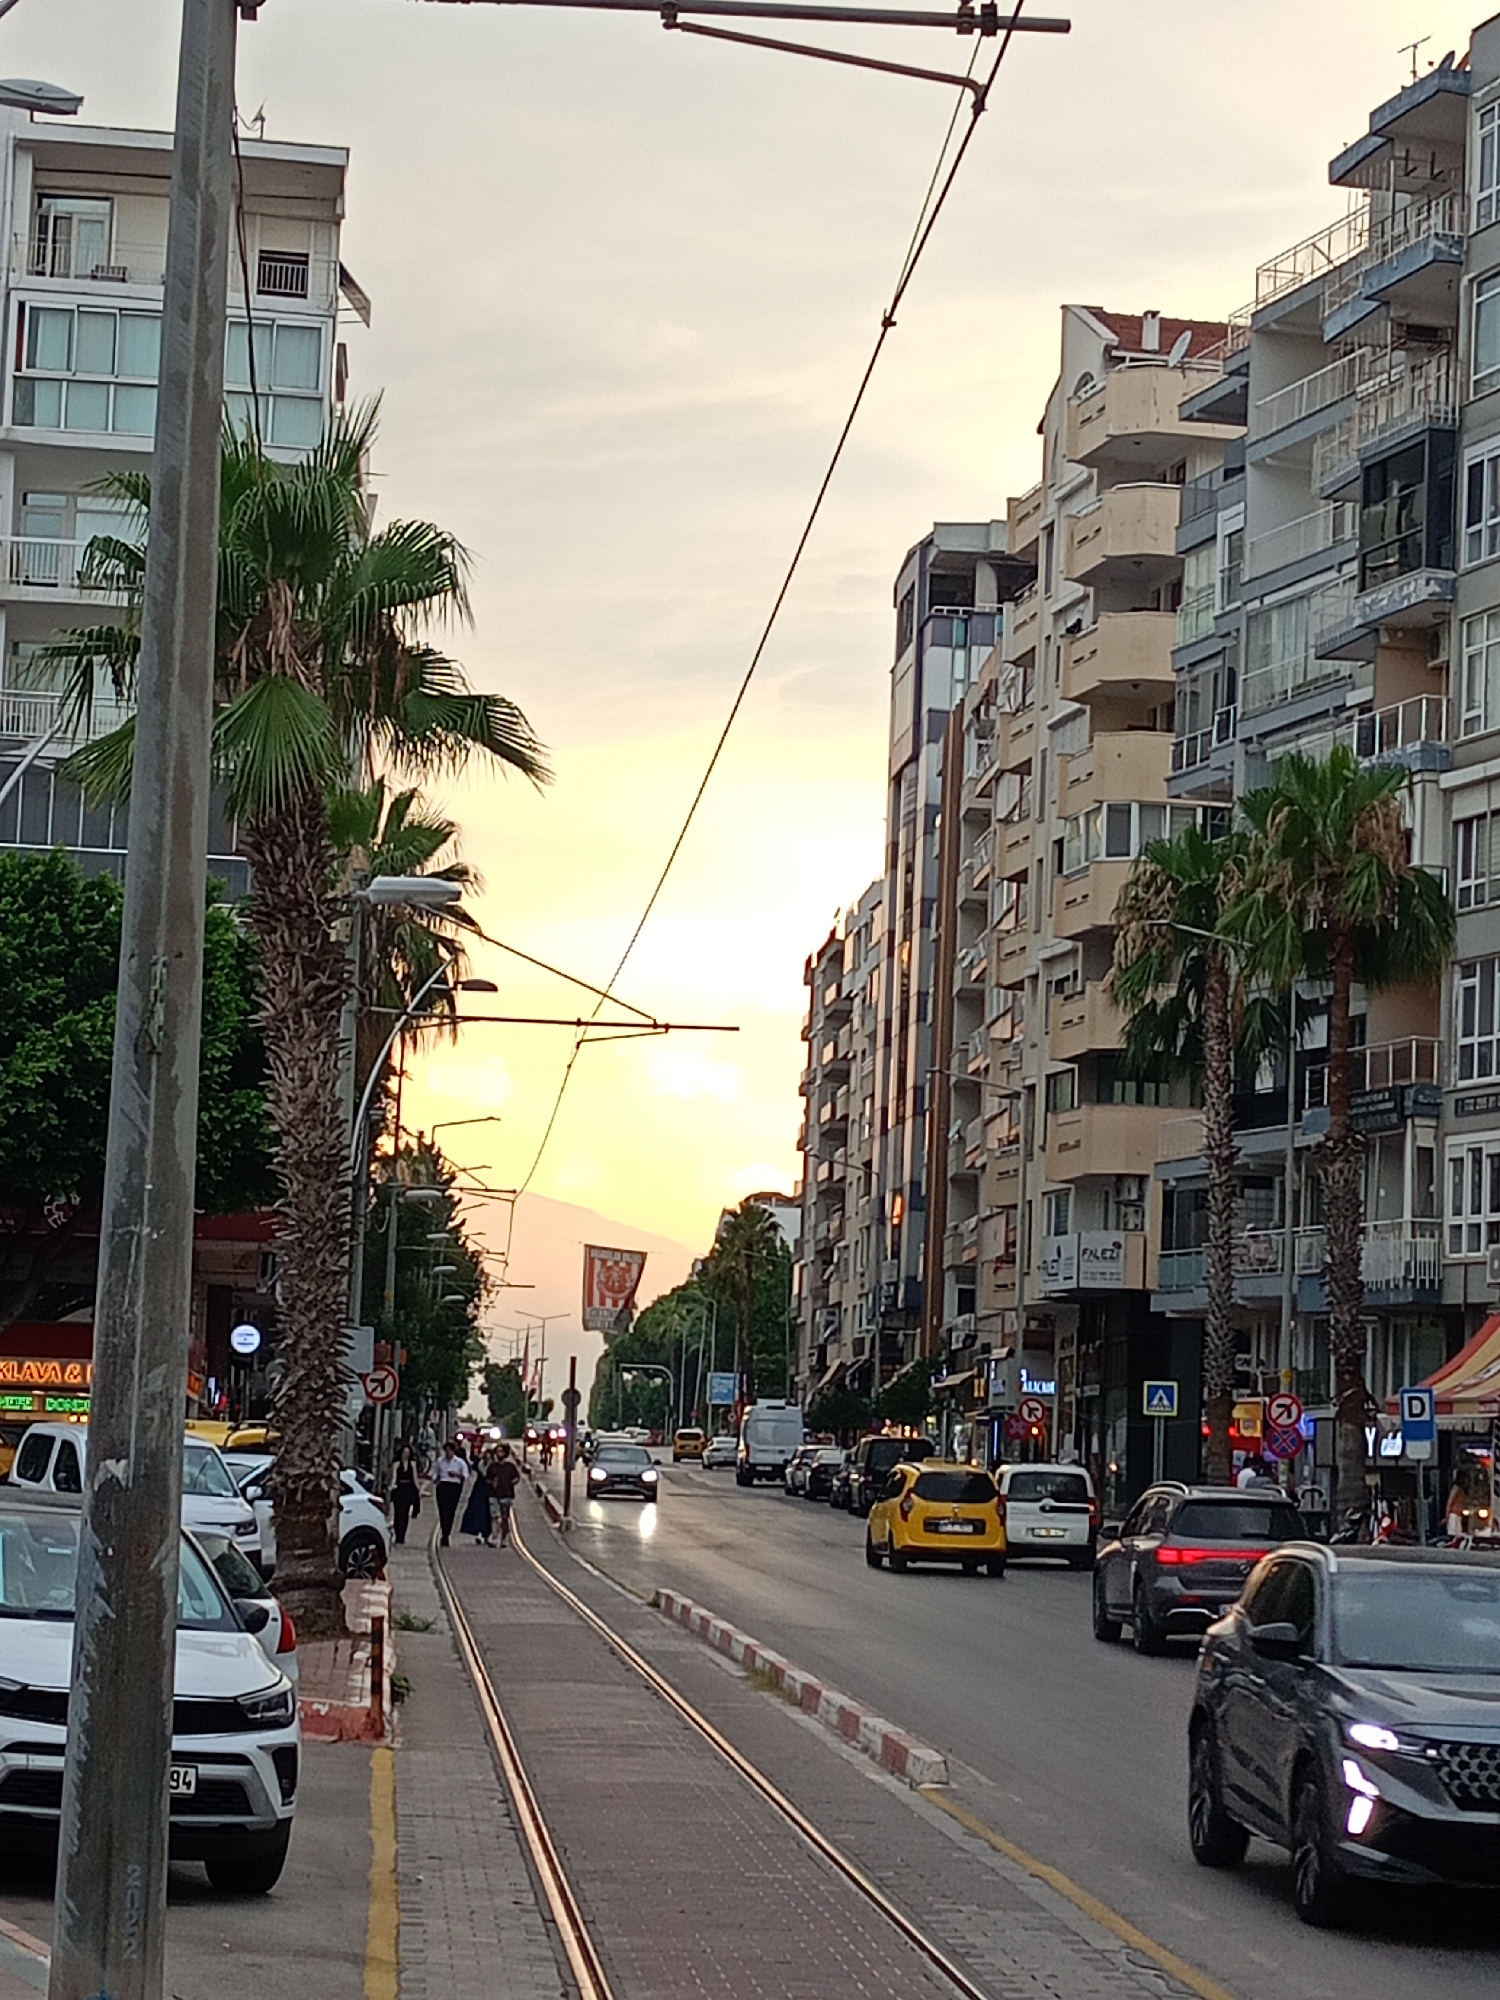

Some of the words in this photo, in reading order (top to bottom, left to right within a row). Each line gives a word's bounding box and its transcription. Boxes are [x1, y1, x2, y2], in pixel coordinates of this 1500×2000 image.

[64, 1363, 82, 1383] &
[1407, 1395, 1426, 1418] D
[170, 1769, 192, 1791] 94
[122, 1864, 142, 1959] 2022
